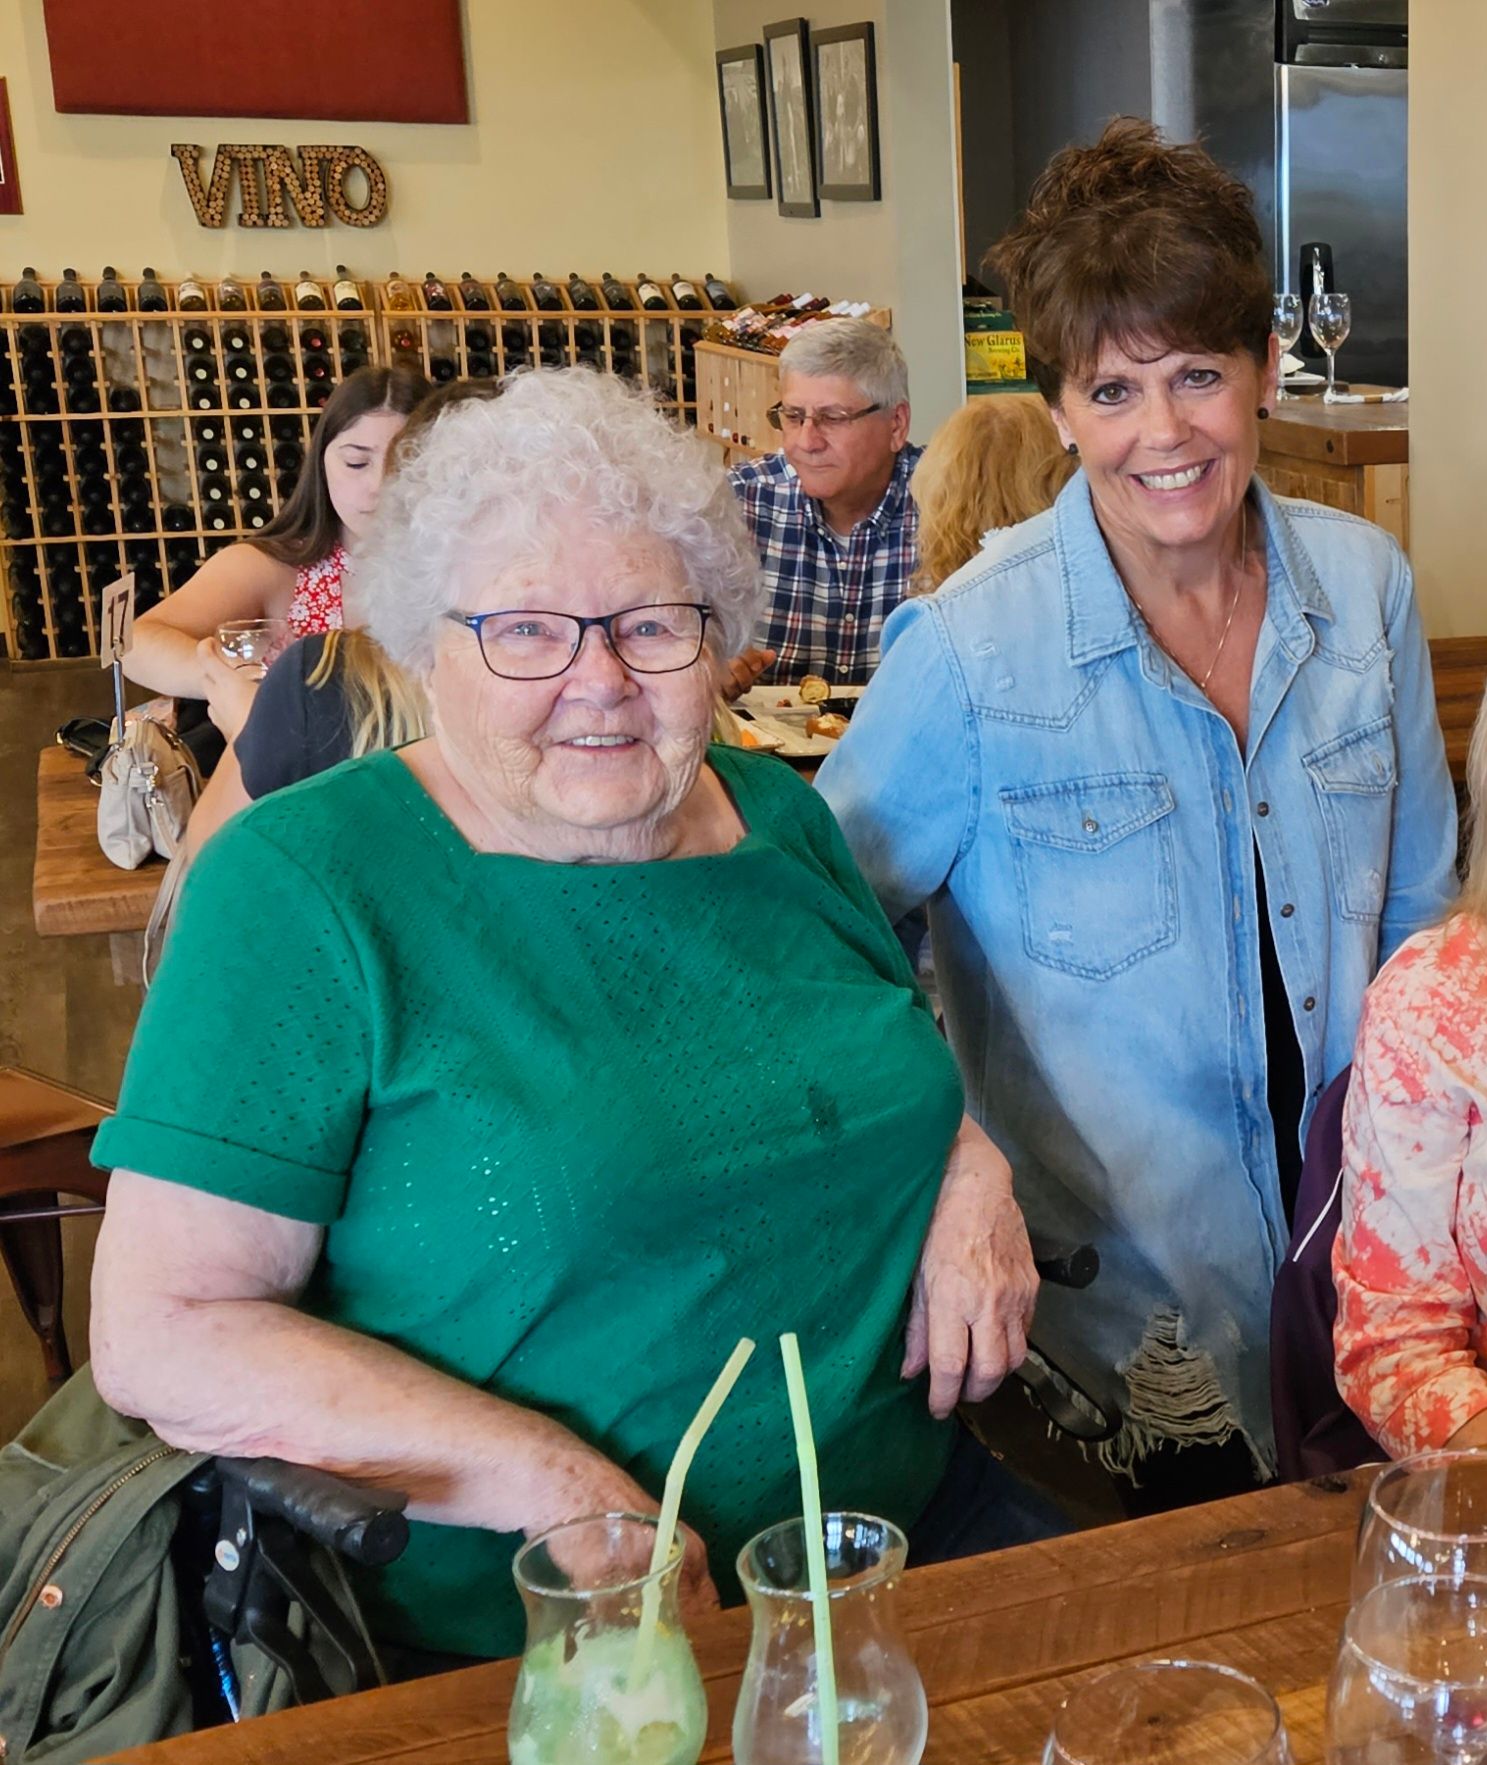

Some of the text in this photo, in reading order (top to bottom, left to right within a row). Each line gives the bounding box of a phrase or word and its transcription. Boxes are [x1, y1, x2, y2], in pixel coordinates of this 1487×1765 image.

[171, 144, 387, 228] VINO
[965, 334, 1021, 347] New Glarus
[108, 589, 129, 649] 17
